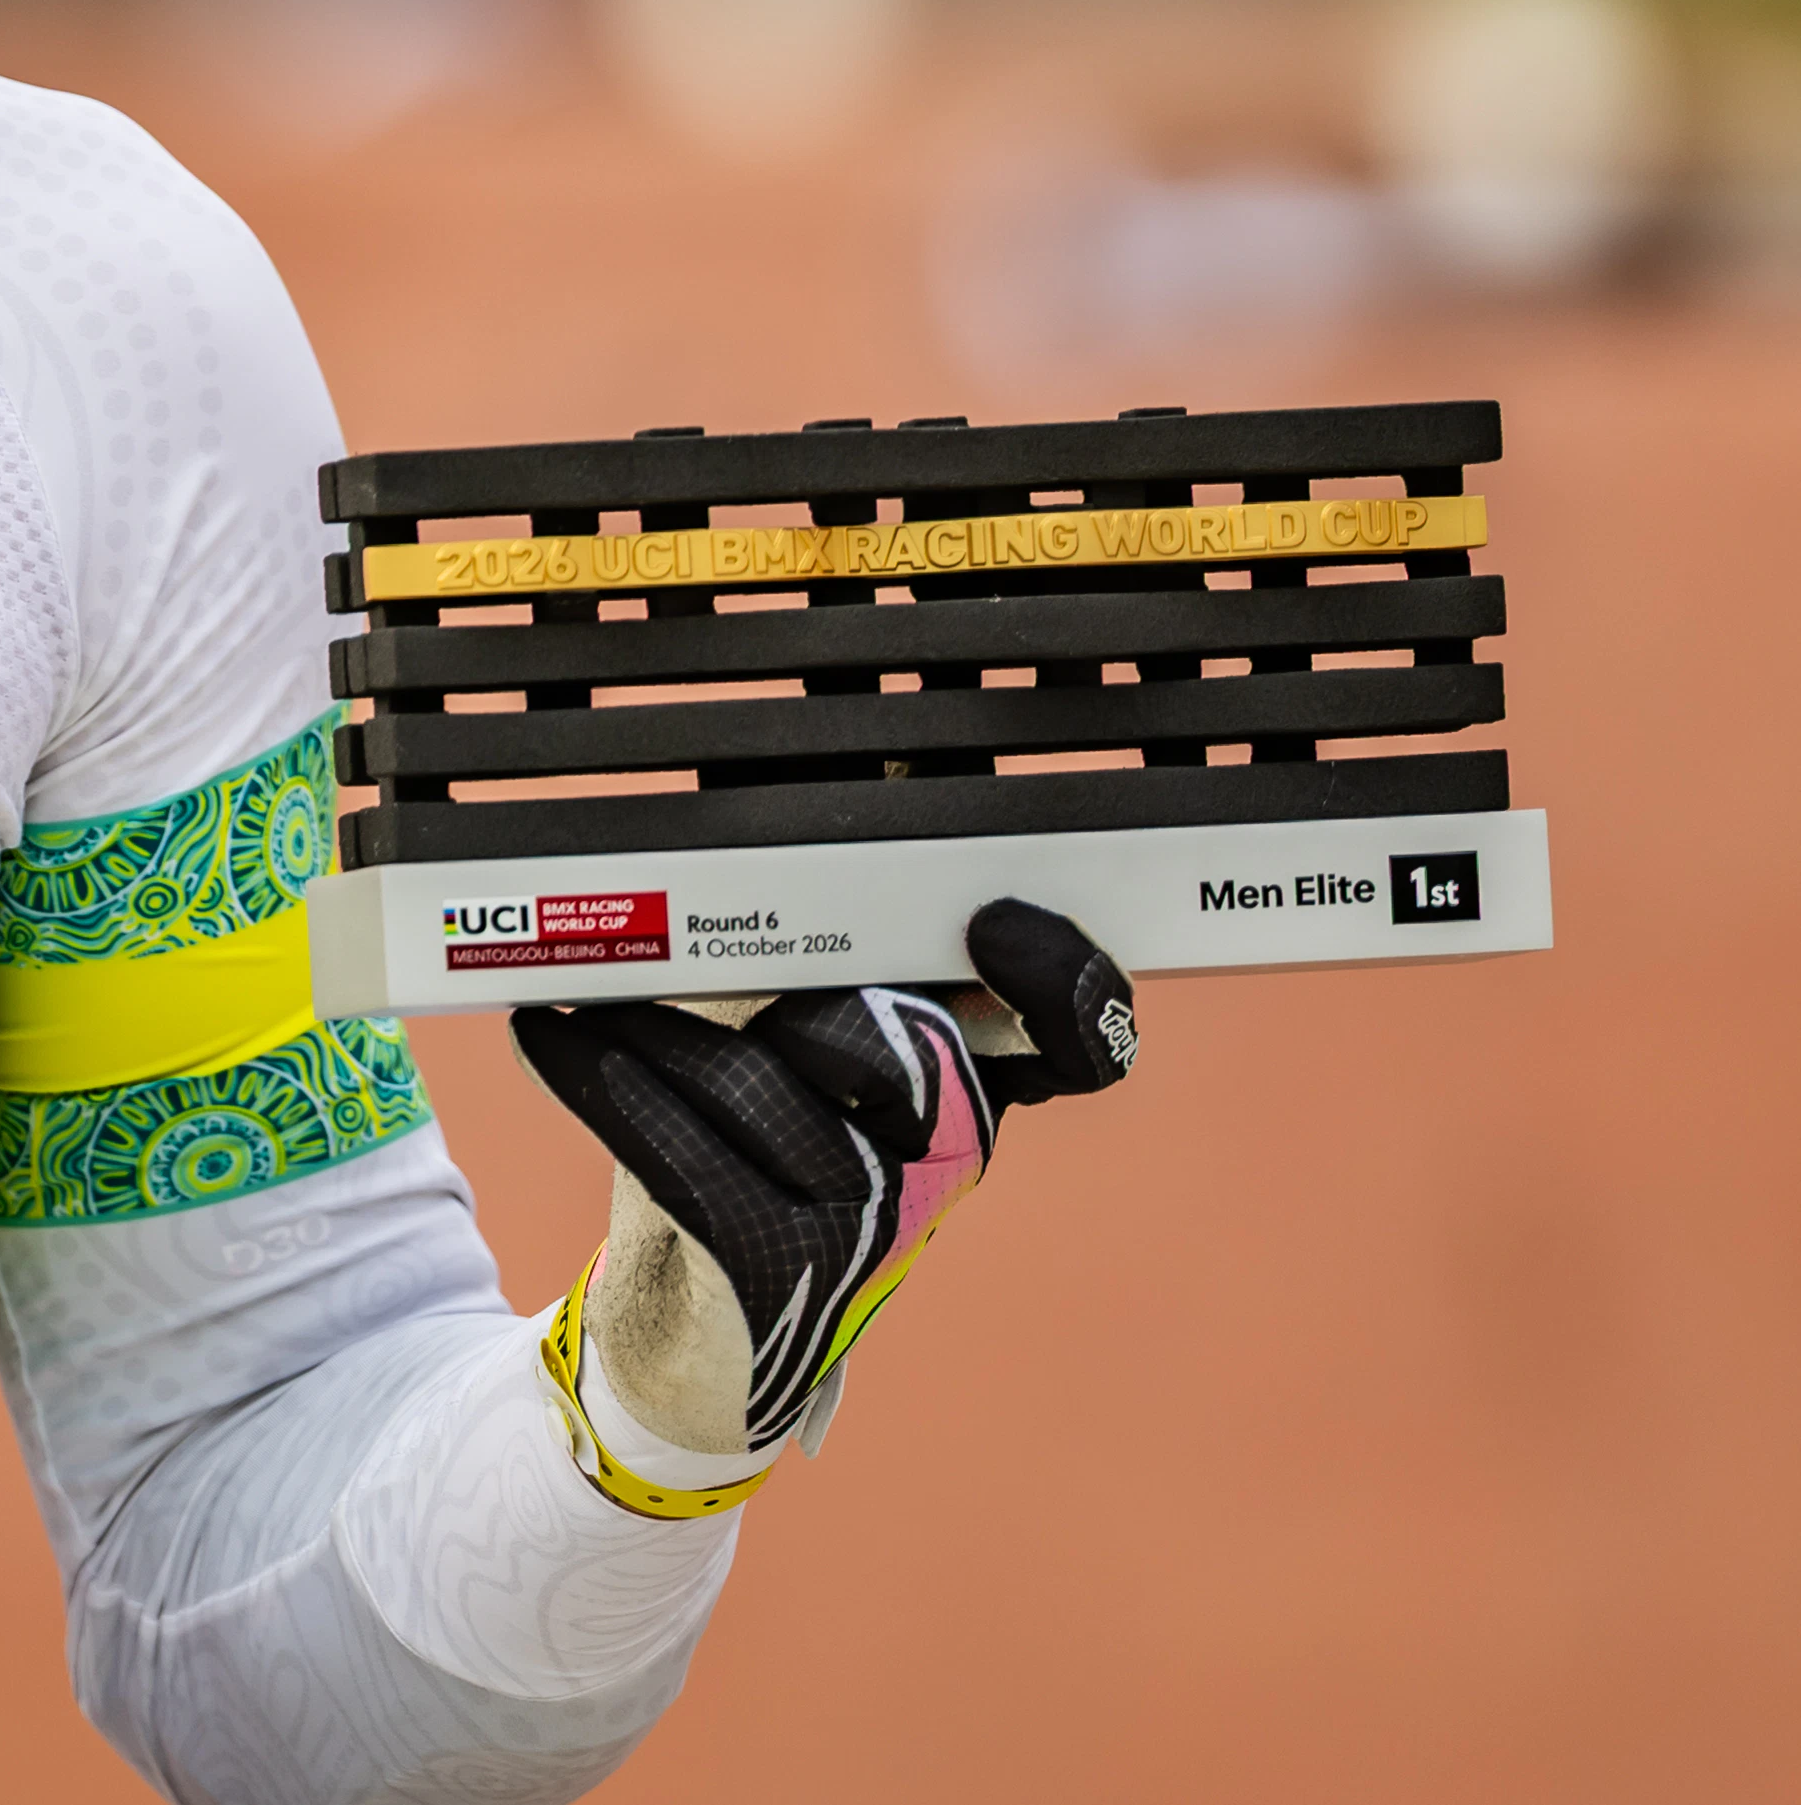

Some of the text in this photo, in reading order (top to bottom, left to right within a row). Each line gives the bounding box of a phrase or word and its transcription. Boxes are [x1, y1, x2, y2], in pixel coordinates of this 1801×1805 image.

[434, 500, 1429, 590] 2026 UCI BMX RACING WORLD CUP
[1199, 873, 1376, 912] Men Elite
[1409, 865, 1460, 909] 1st
[460, 904, 530, 935] UCI
[542, 898, 635, 917] BMX RACING
[542, 914, 629, 934] WORLD CUP
[687, 911, 780, 934] Round 6
[452, 941, 661, 965] MENTOUGOU-BEIJING CHINA
[687, 932, 853, 958] 4 October 2026
